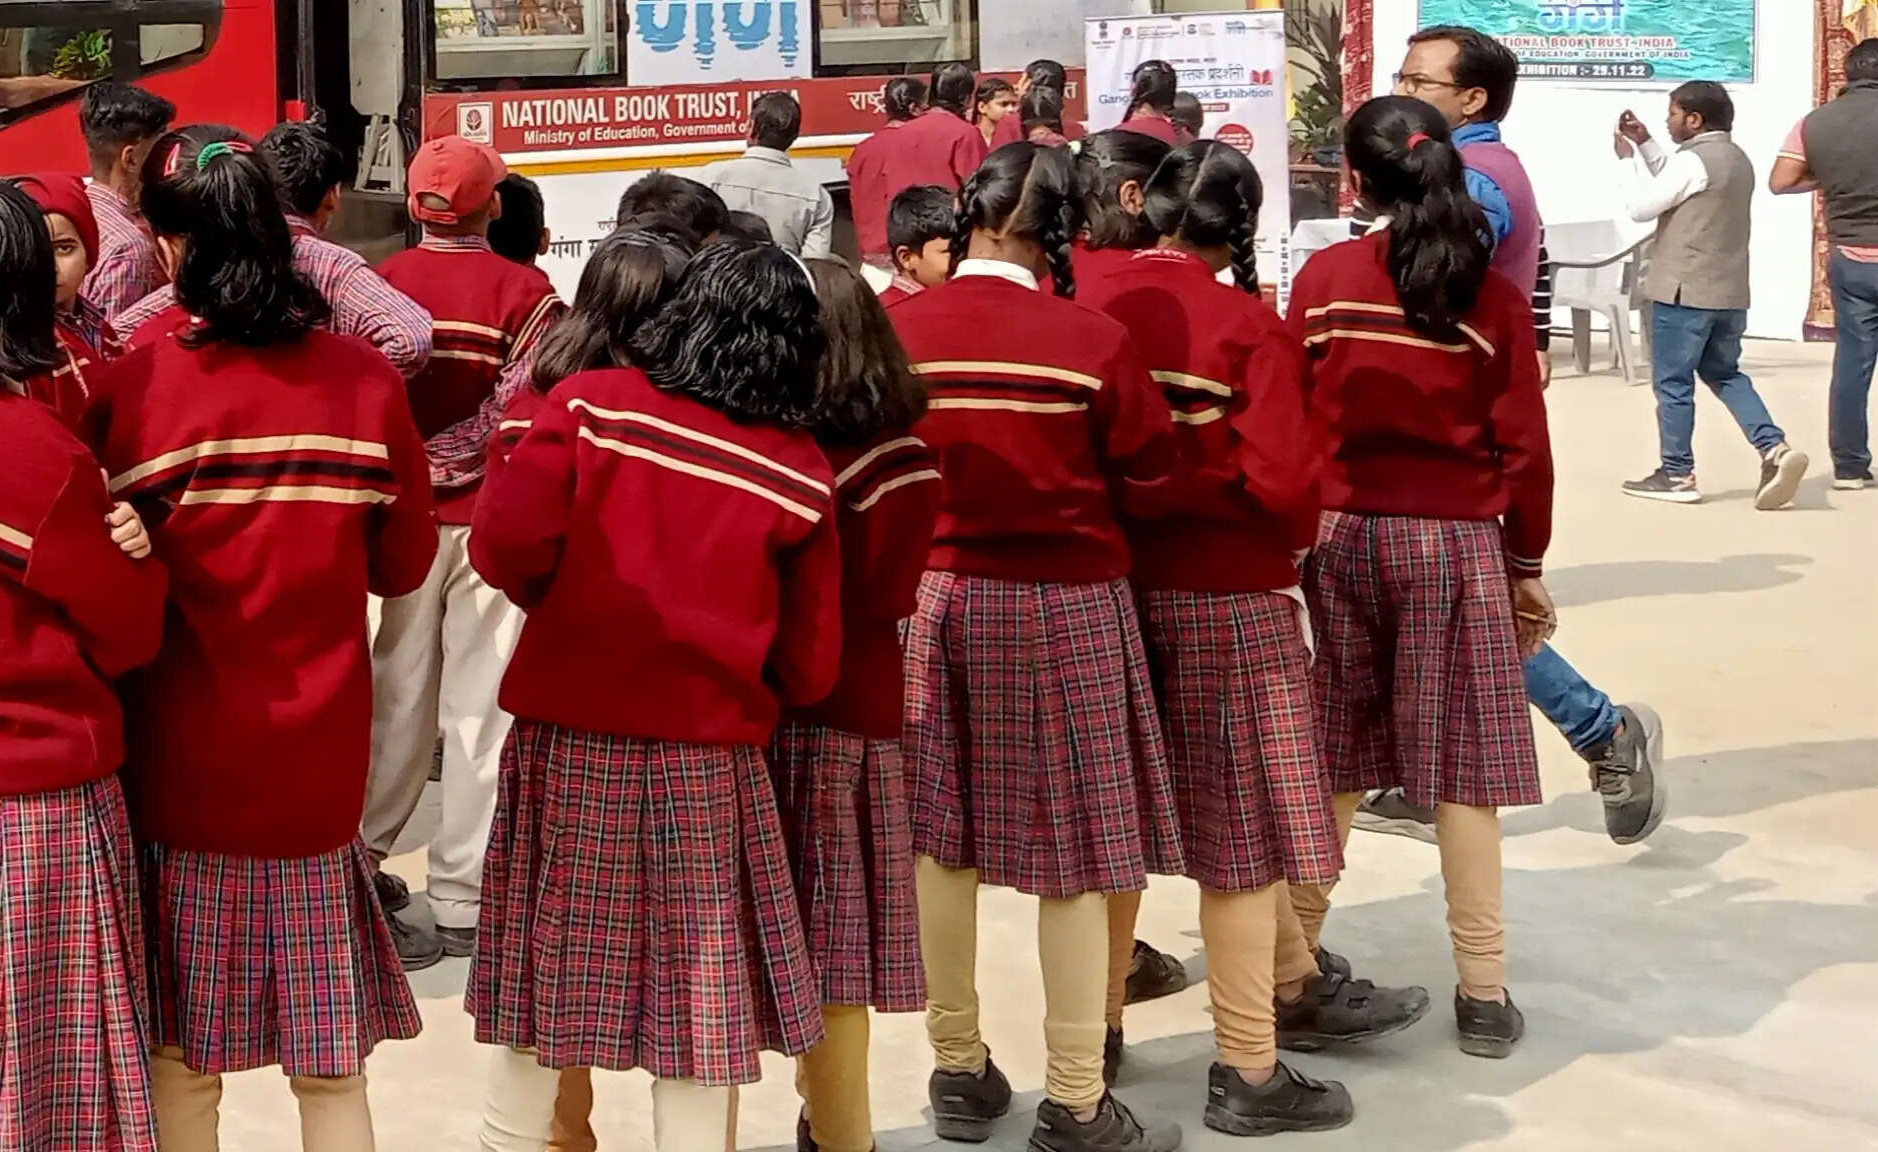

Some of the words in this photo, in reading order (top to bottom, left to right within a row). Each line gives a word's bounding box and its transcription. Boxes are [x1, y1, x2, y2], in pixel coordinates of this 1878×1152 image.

[1498, 37, 1545, 47] TIONAL
[1551, 37, 1584, 47] BOOK
[1214, 86, 1273, 99] Exhibition
[502, 96, 609, 128] NATIONAL
[614, 93, 671, 122] BOOK
[675, 91, 742, 120] TRUST,
[524, 126, 576, 146] Ministry
[578, 126, 592, 142] of
[594, 123, 660, 142] Education,
[663, 120, 737, 138] Government
[550, 236, 583, 259] गंगा
